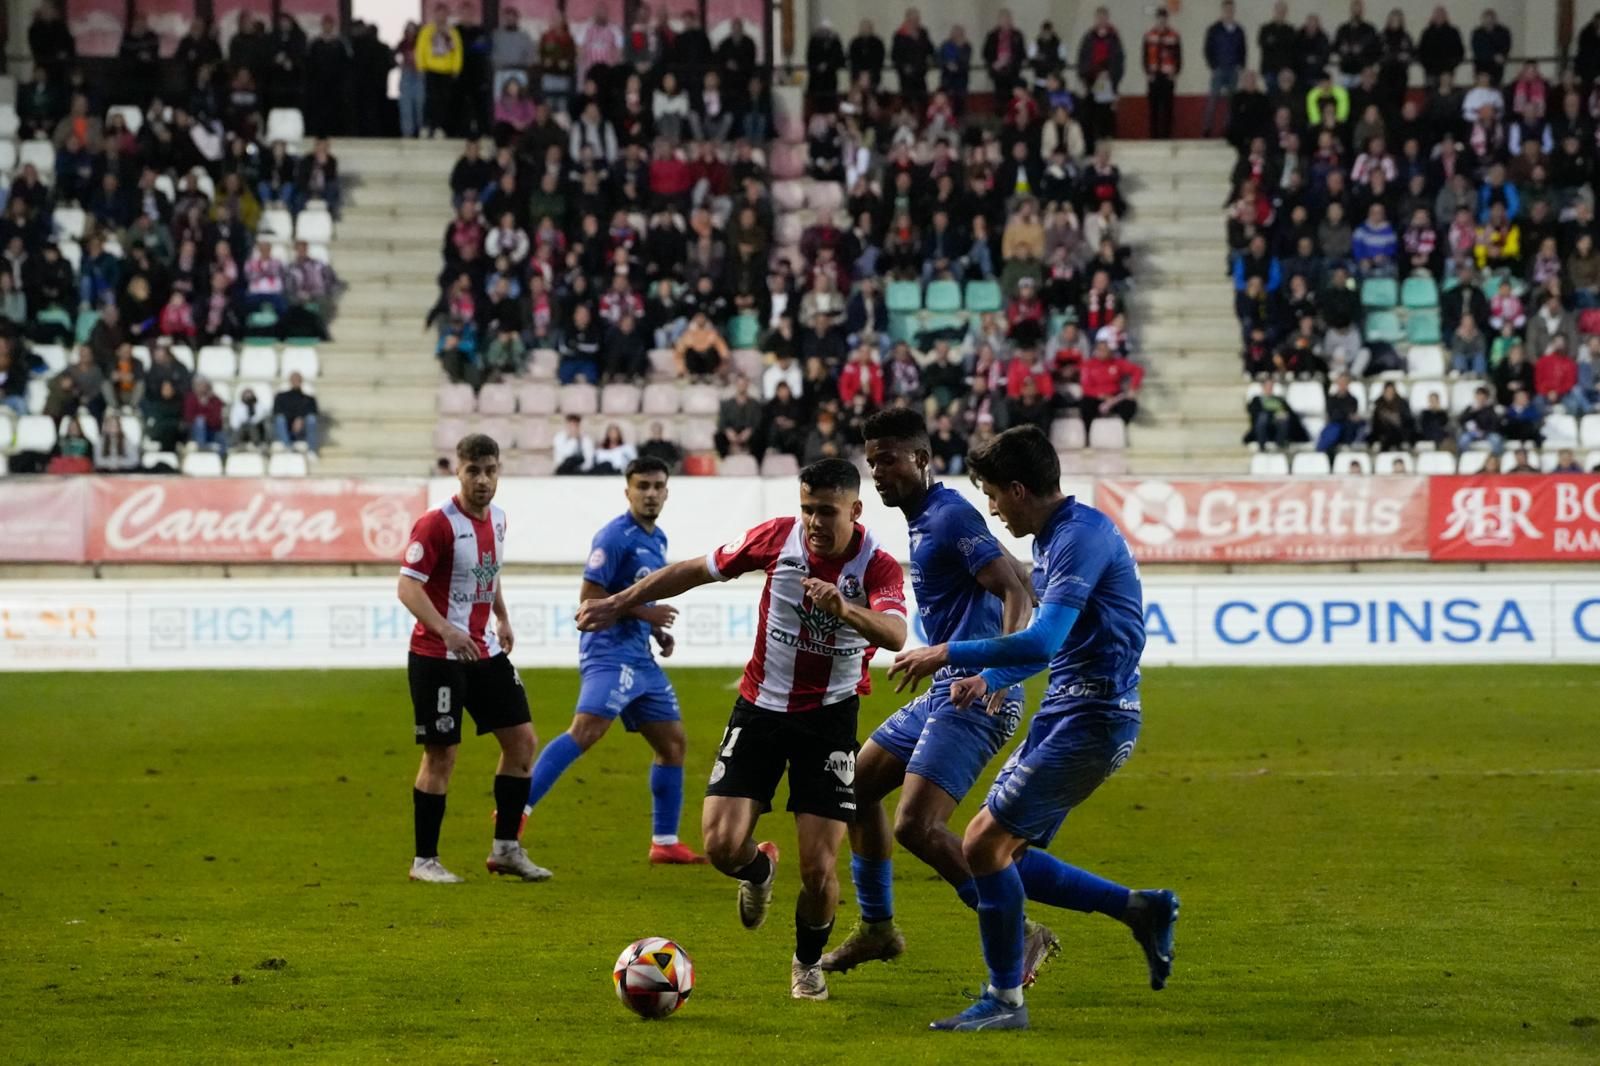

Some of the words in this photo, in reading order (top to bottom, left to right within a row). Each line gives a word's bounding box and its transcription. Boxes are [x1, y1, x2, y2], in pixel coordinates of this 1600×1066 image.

[105, 484, 343, 560] Cardiza
[1198, 484, 1403, 537] Cualtis
[193, 606, 294, 641] HGM
[770, 628, 807, 651] CAJA
[1213, 600, 1535, 644] COPINSA
[619, 663, 634, 690] 16
[437, 686, 452, 713] 8
